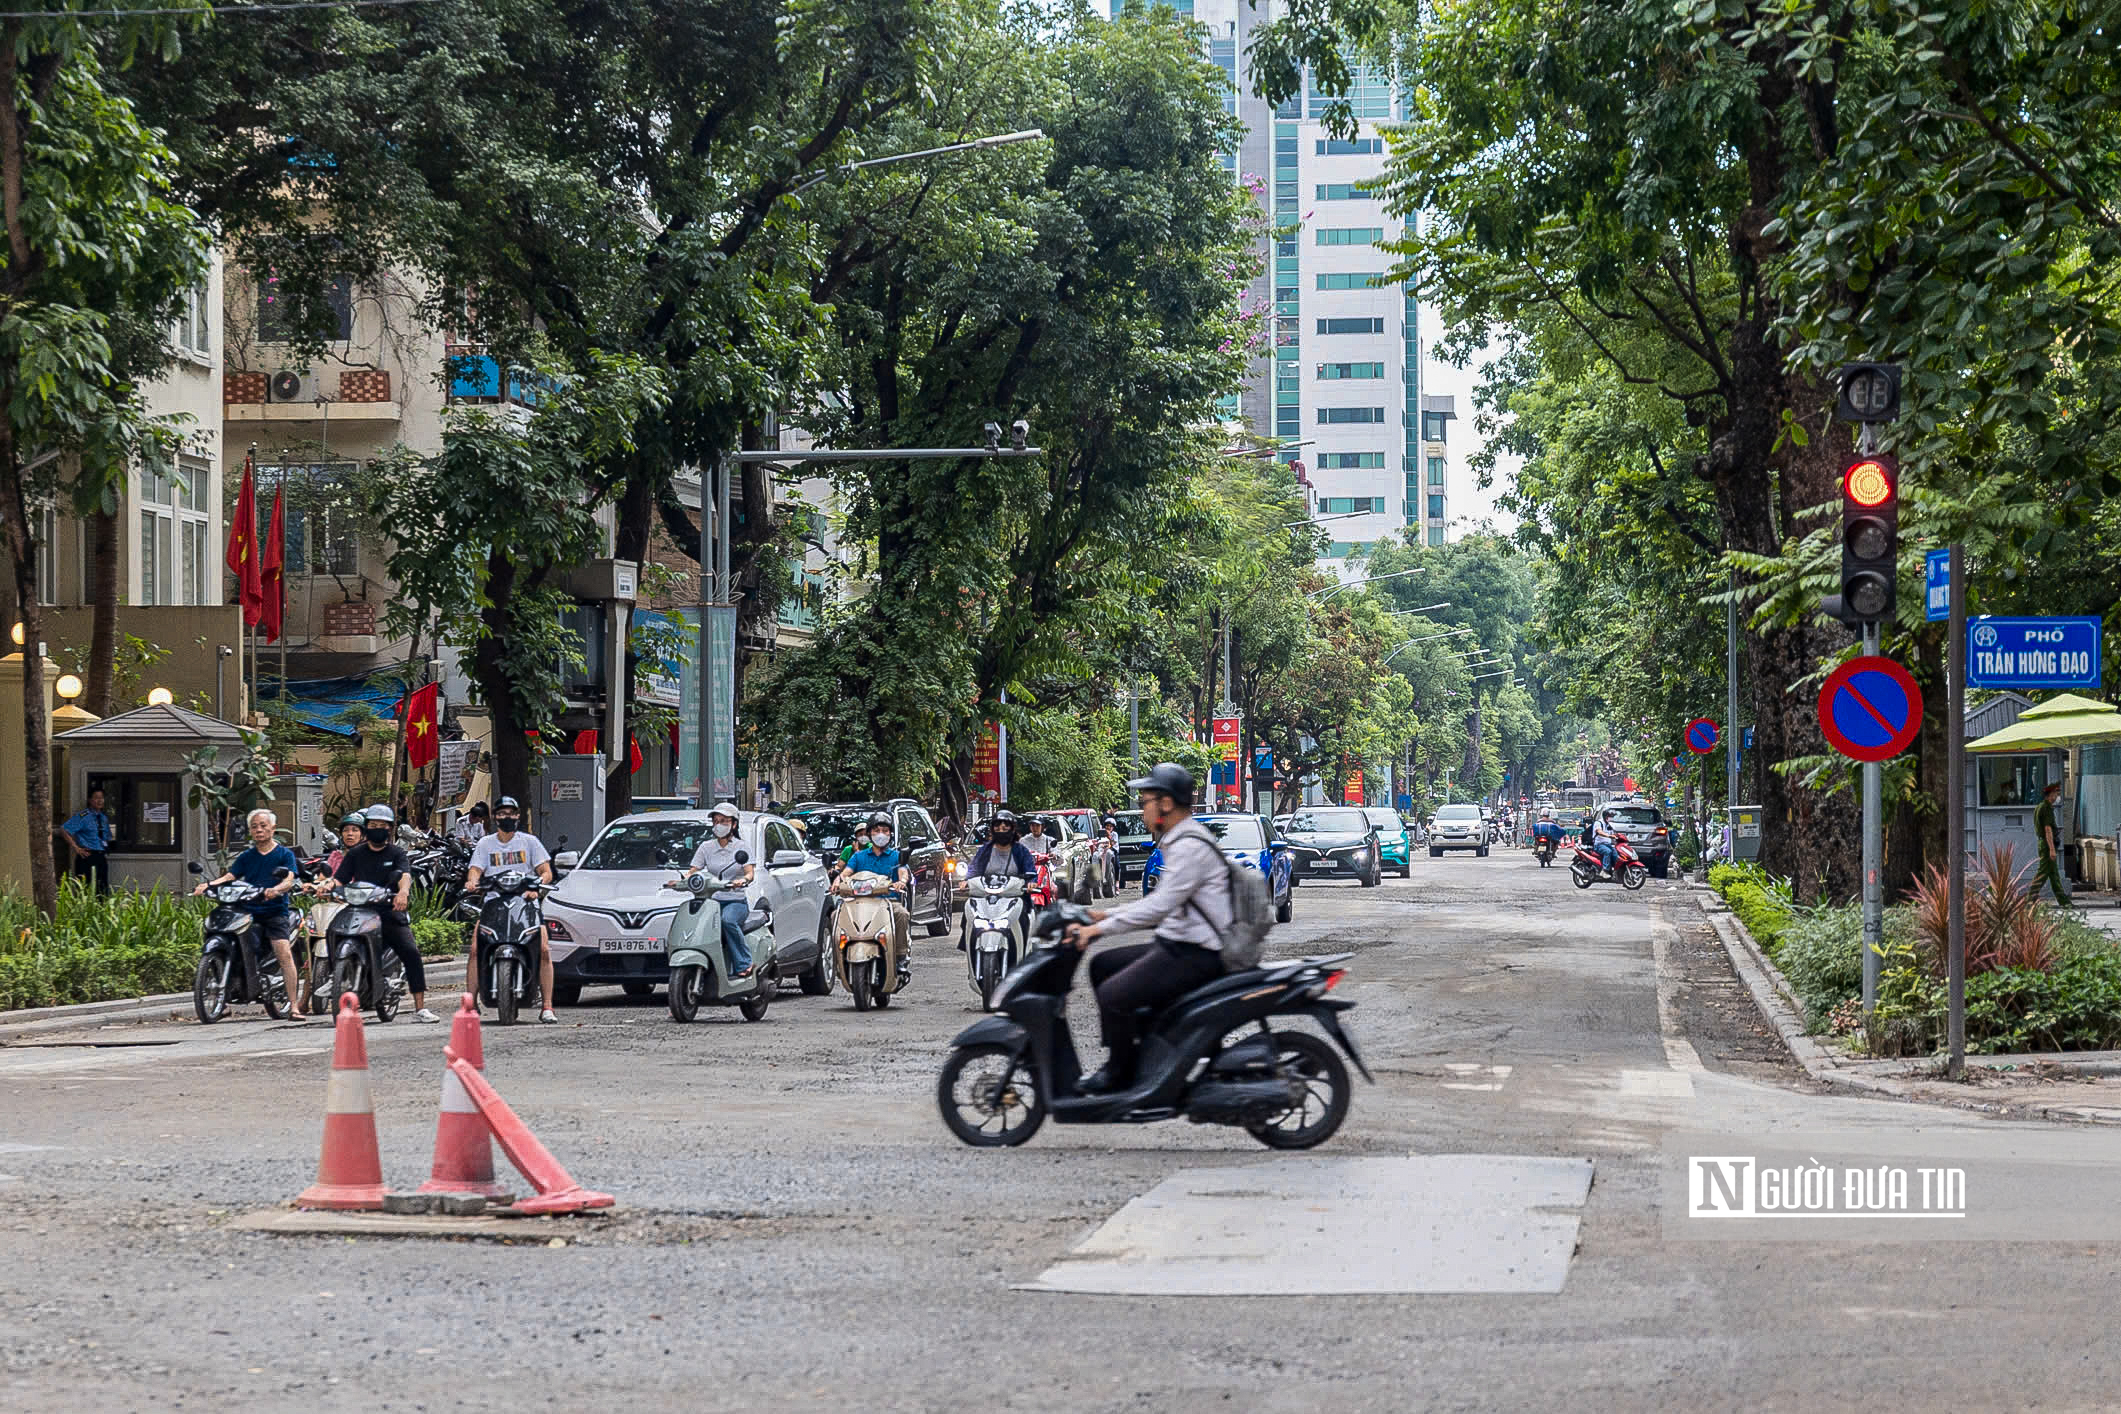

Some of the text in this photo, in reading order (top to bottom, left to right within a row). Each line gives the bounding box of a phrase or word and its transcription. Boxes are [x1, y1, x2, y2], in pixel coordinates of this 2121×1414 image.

[2025, 625, 2065, 642] PHỐ
[2019, 649, 2056, 674] HƯNG
[2061, 651, 2088, 678] ĐẠO
